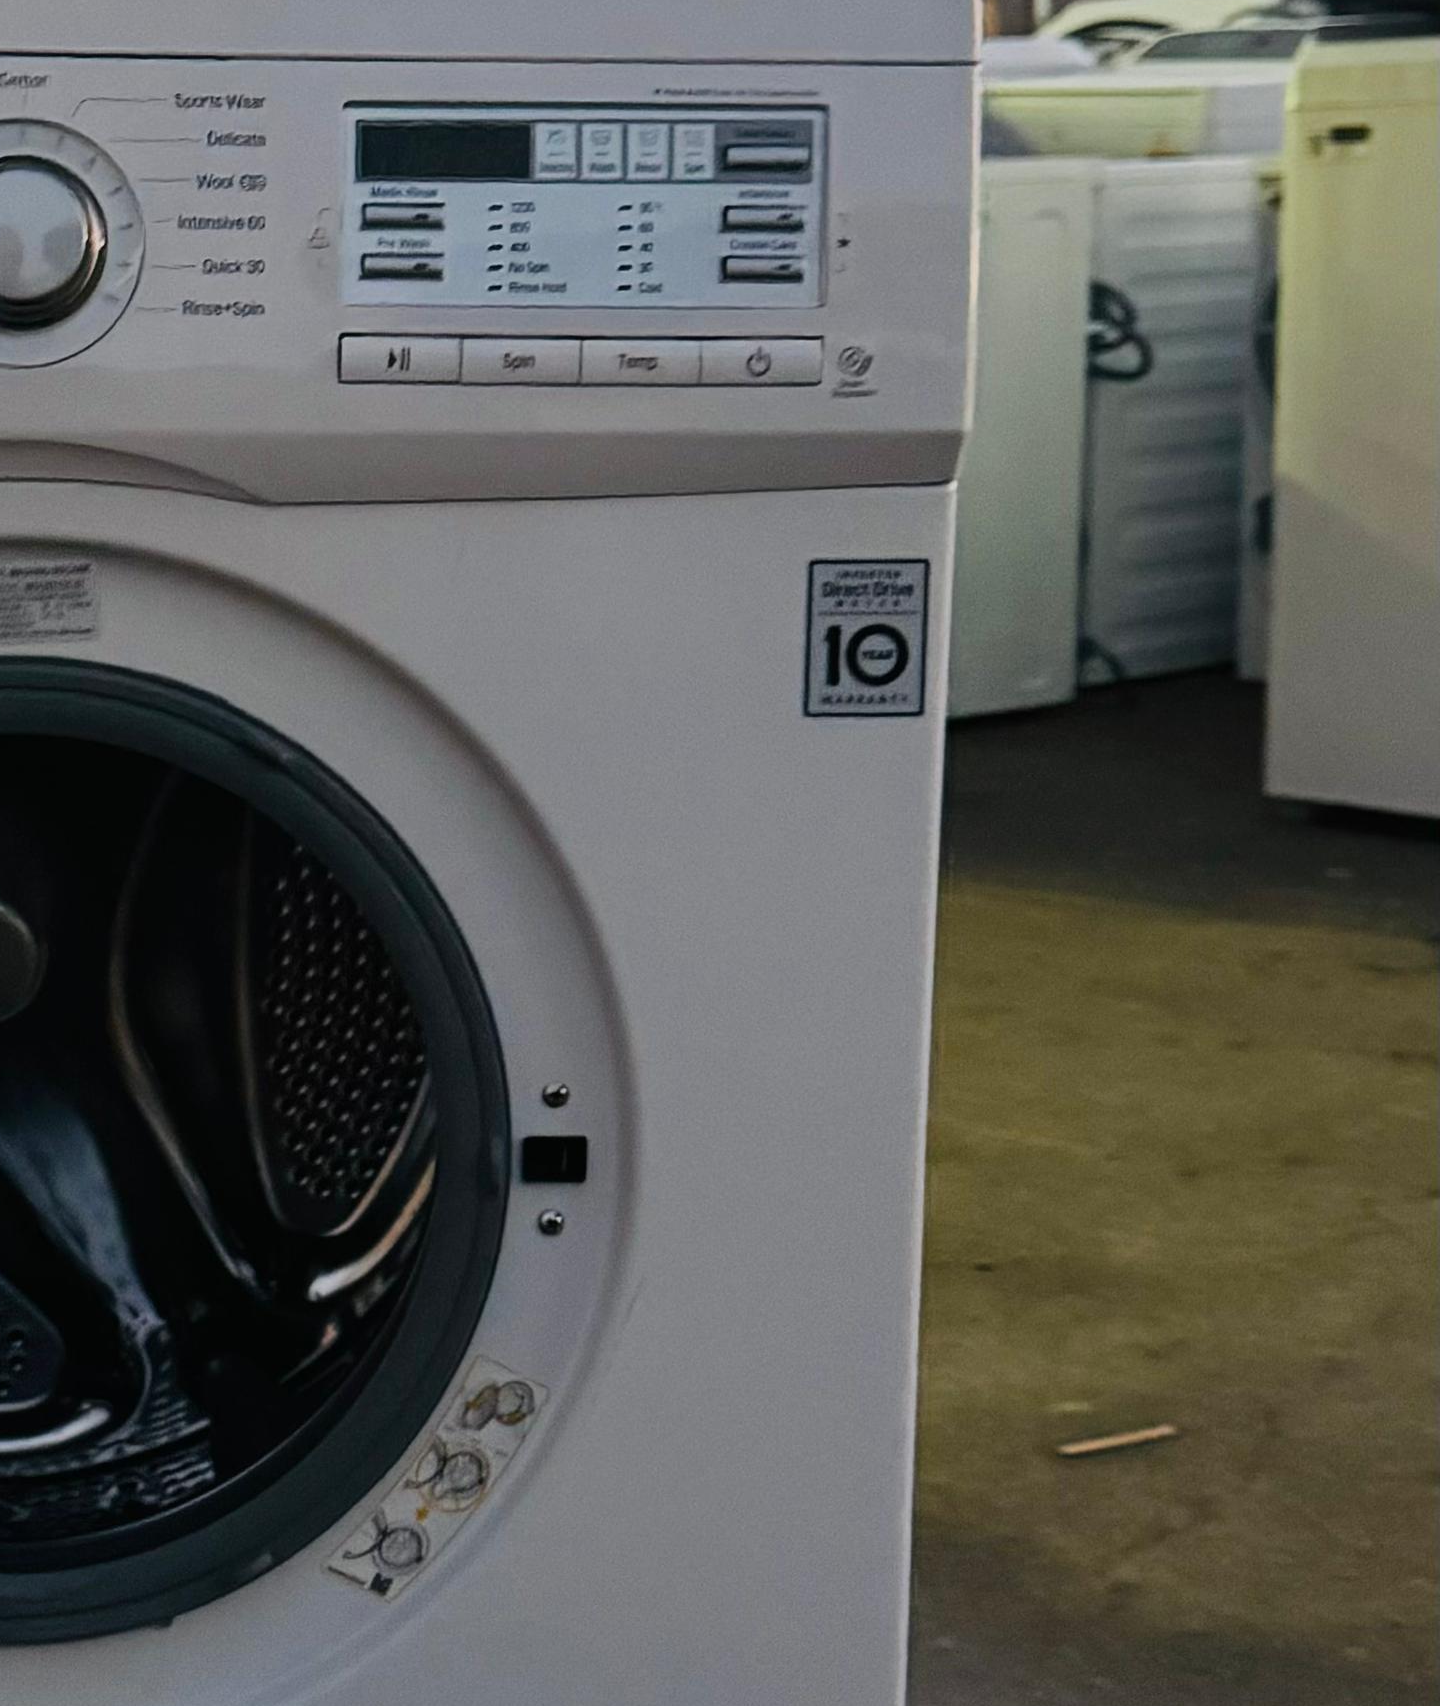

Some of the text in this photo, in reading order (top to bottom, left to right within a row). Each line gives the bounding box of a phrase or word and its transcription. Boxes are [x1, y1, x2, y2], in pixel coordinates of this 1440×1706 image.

[178, 215, 245, 230] Intensive
[502, 353, 537, 372] Spin
[822, 580, 915, 598] Direct Drive
[824, 623, 909, 687] 10
